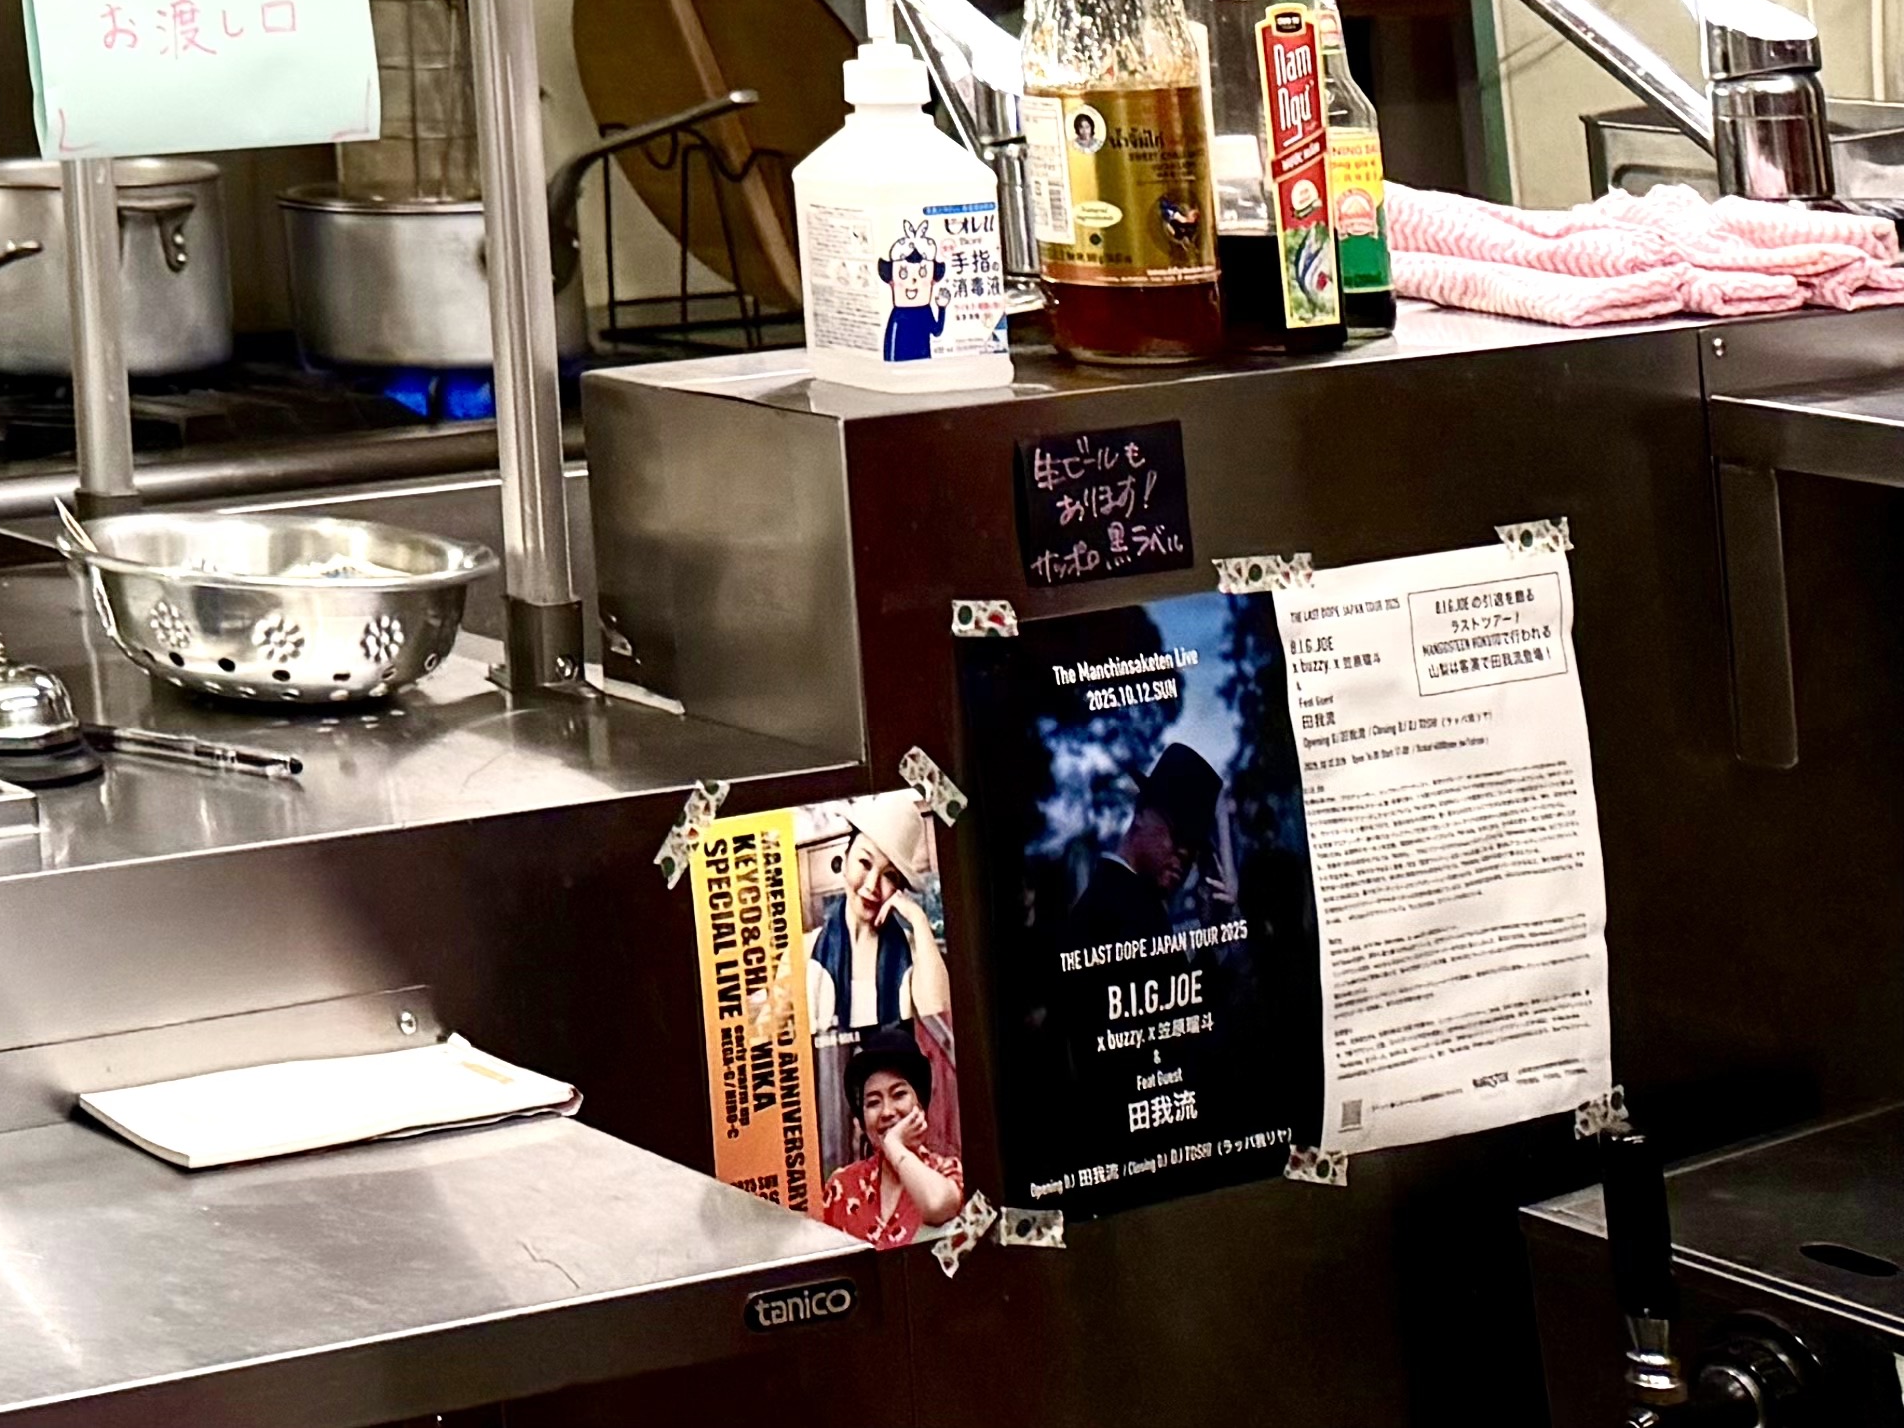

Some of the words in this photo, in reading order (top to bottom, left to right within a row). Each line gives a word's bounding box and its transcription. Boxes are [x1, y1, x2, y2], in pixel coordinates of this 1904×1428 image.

[1273, 43, 1312, 86] Nam
[1034, 436, 1146, 490] 生ビールも
[1052, 666, 1076, 685] The
[1174, 647, 1198, 667] Live
[704, 839, 738, 955] SPECIAL
[1060, 952, 1082, 972] THE
[1084, 944, 1113, 968] LAST
[1116, 938, 1147, 962] DOPE
[1150, 931, 1187, 957] JAPAN
[1189, 927, 1218, 951] TOUR
[1220, 919, 1248, 942] 2025
[716, 960, 743, 1020] LIVE
[1107, 969, 1203, 1020] B.I.G.JOE
[779, 1052, 808, 1212] ANNIVERSARY
[1128, 1090, 1198, 1133] 田我流
[1079, 1163, 1120, 1187] 田我流
[754, 1289, 851, 1326] tanico
